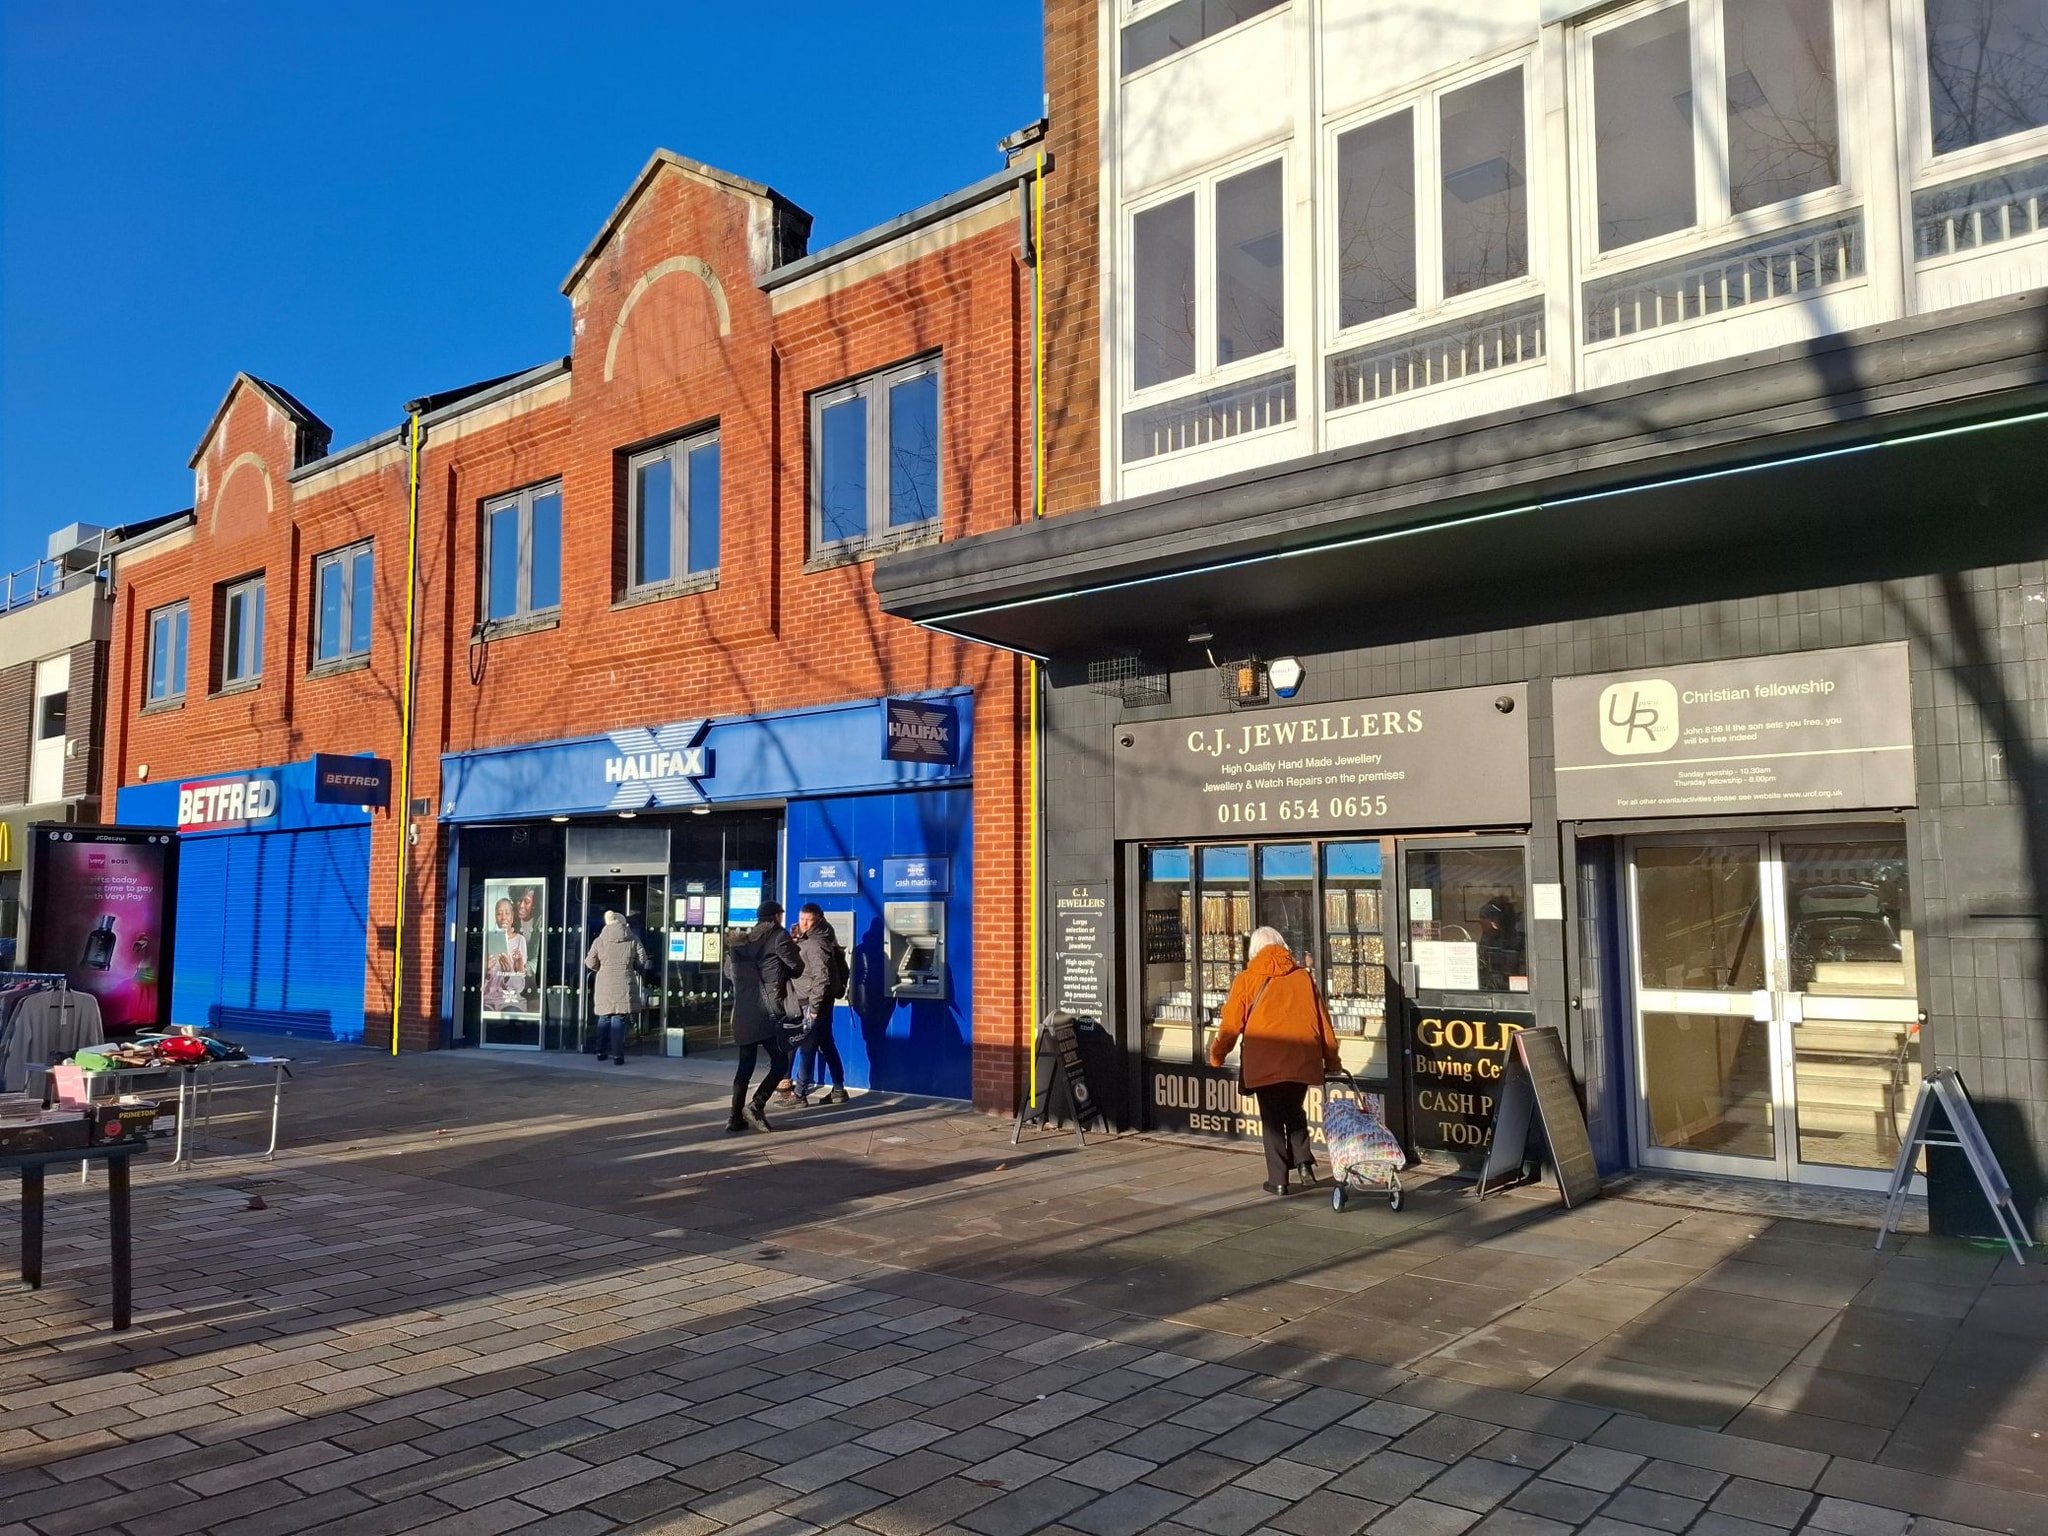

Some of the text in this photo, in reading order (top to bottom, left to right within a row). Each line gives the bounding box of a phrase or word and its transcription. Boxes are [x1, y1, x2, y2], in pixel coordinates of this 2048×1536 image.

[1682, 679, 1835, 705] Christian fellowship
[888, 722, 949, 741] HALIFAX
[1187, 709, 1424, 757] C.J. JEWELLERS
[1683, 726, 1704, 736] John
[1732, 723, 1747, 732] the
[1748, 723, 1764, 731] son
[1765, 720, 1783, 730] sets
[1783, 720, 1802, 730] you
[1825, 716, 1843, 727] you
[1683, 732, 1758, 745] will be free indeed
[605, 749, 703, 783] HALIFAX
[1221, 753, 1382, 775] High Quality Hand Made Jewellery
[325, 774, 380, 788] BETFRED
[1202, 770, 1406, 793] Jewellery & Watch Repairs on the premises
[1678, 769, 1705, 779] Sunday
[1706, 768, 1734, 778] worship
[1674, 778, 1707, 788] Thursday
[1707, 776, 1743, 786] fellowship
[178, 779, 278, 826] BETFRED
[1617, 798, 1629, 807] For
[1639, 797, 1656, 806] other
[1713, 793, 1737, 803] please
[1753, 791, 1781, 801] website
[1218, 795, 1388, 824] 0161 654 0655
[111, 876, 138, 886] today
[808, 878, 847, 888] cash machine
[895, 877, 938, 888] cash machine
[104, 892, 125, 902] Very
[126, 892, 144, 902] Pay
[136, 885, 154, 894] pay
[1057, 898, 1106, 908] JEWELLERS
[1068, 942, 1092, 951] jewellery
[1065, 959, 1096, 967] High quality
[1066, 967, 1089, 975] jewellery
[1079, 1008, 1103, 1016] batteries
[1415, 1054, 1473, 1082] Buying
[1155, 1073, 1200, 1110] GOLD
[1206, 1078, 1261, 1116] BOUG
[1419, 1090, 1474, 1115] CASH
[1189, 1112, 1232, 1134] BEST
[1236, 1118, 1264, 1137] PRI
[1438, 1121, 1493, 1147] TODA
